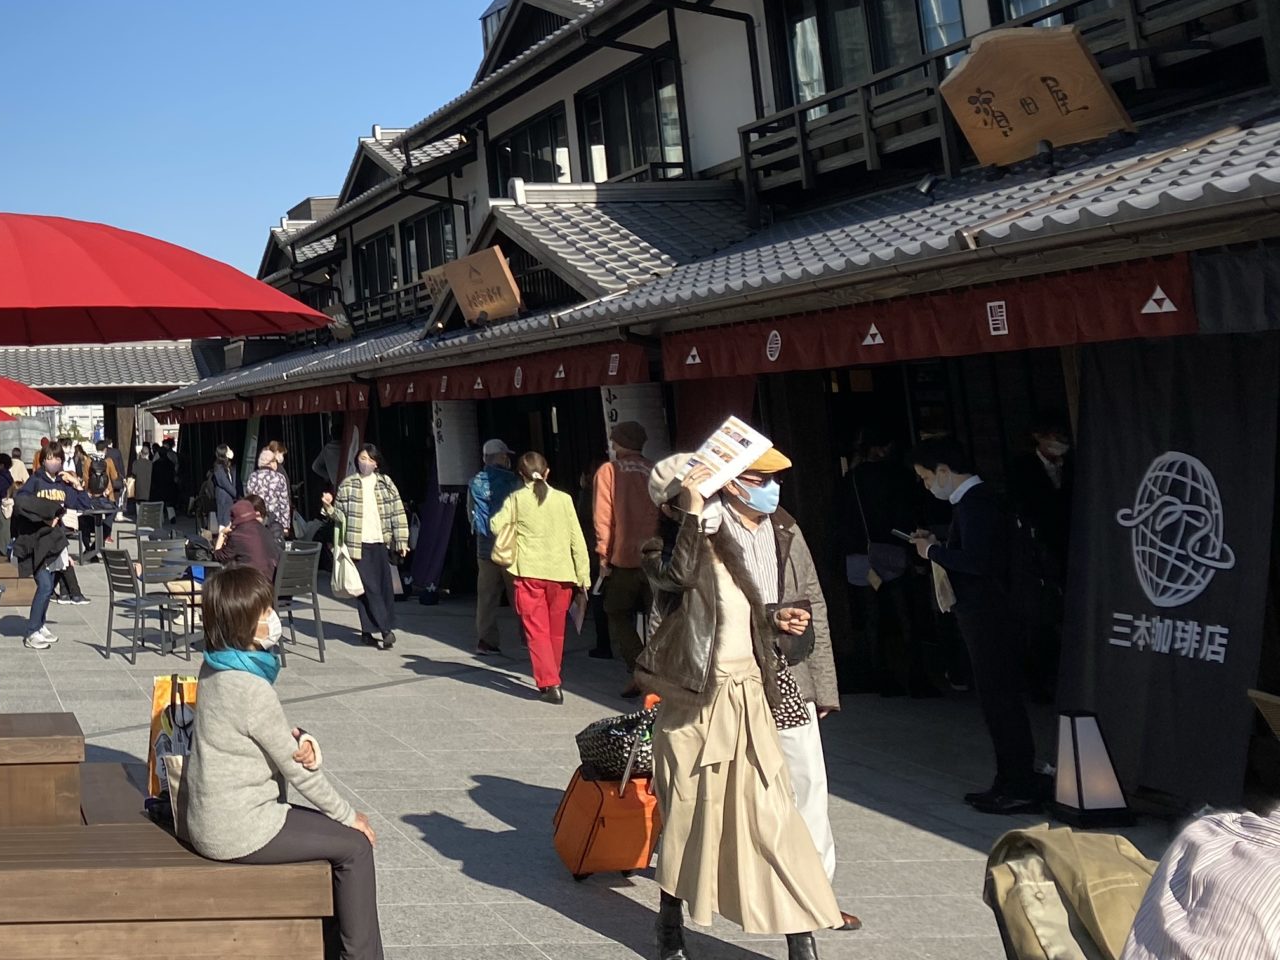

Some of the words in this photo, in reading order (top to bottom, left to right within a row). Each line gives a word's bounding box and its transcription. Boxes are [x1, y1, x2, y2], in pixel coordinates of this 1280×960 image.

[605, 387, 618, 430] 小田
[1108, 612, 1230, 664] 三本珈琲店
